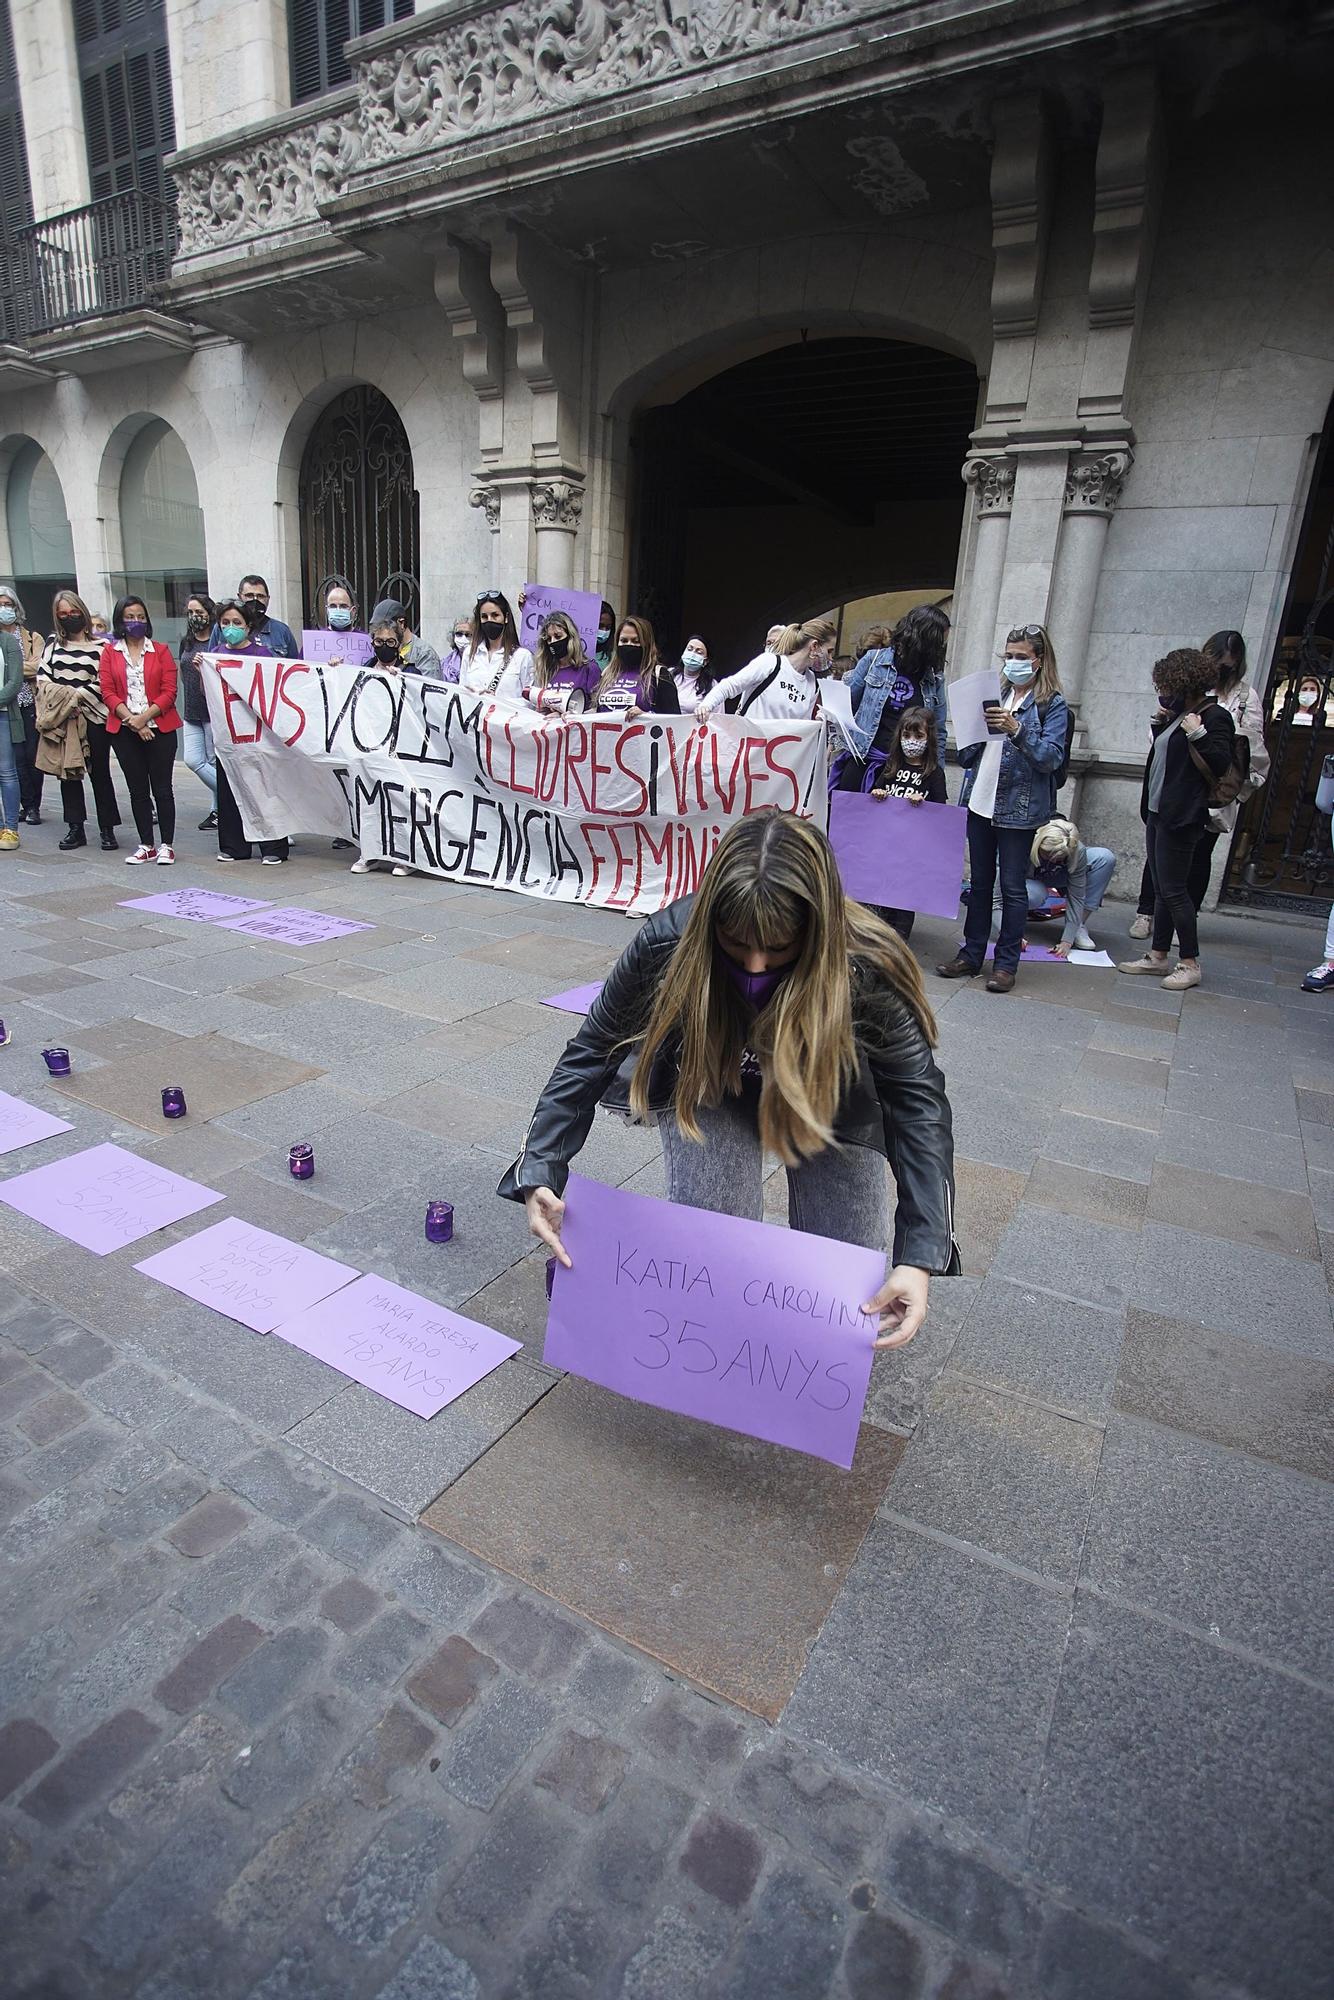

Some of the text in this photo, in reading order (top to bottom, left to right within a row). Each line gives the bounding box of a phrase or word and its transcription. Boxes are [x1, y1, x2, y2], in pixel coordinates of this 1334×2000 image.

[313, 637, 374, 653] EL SILEN
[215, 659, 311, 748] ENS
[315, 666, 488, 778] VOLEM
[482, 704, 649, 818] LLIURES
[96, 1164, 181, 1200] BETTY
[56, 1186, 158, 1238] 52 ANYS
[188, 1261, 279, 1310] 42 ANYS
[615, 1240, 875, 1330] KATIA CAROLINA
[370, 1321, 442, 1359] ALARDO
[418, 1318, 480, 1354] TERESA
[633, 1309, 851, 1411] 35 ANYS
[342, 1331, 454, 1398] 48 ANYS
